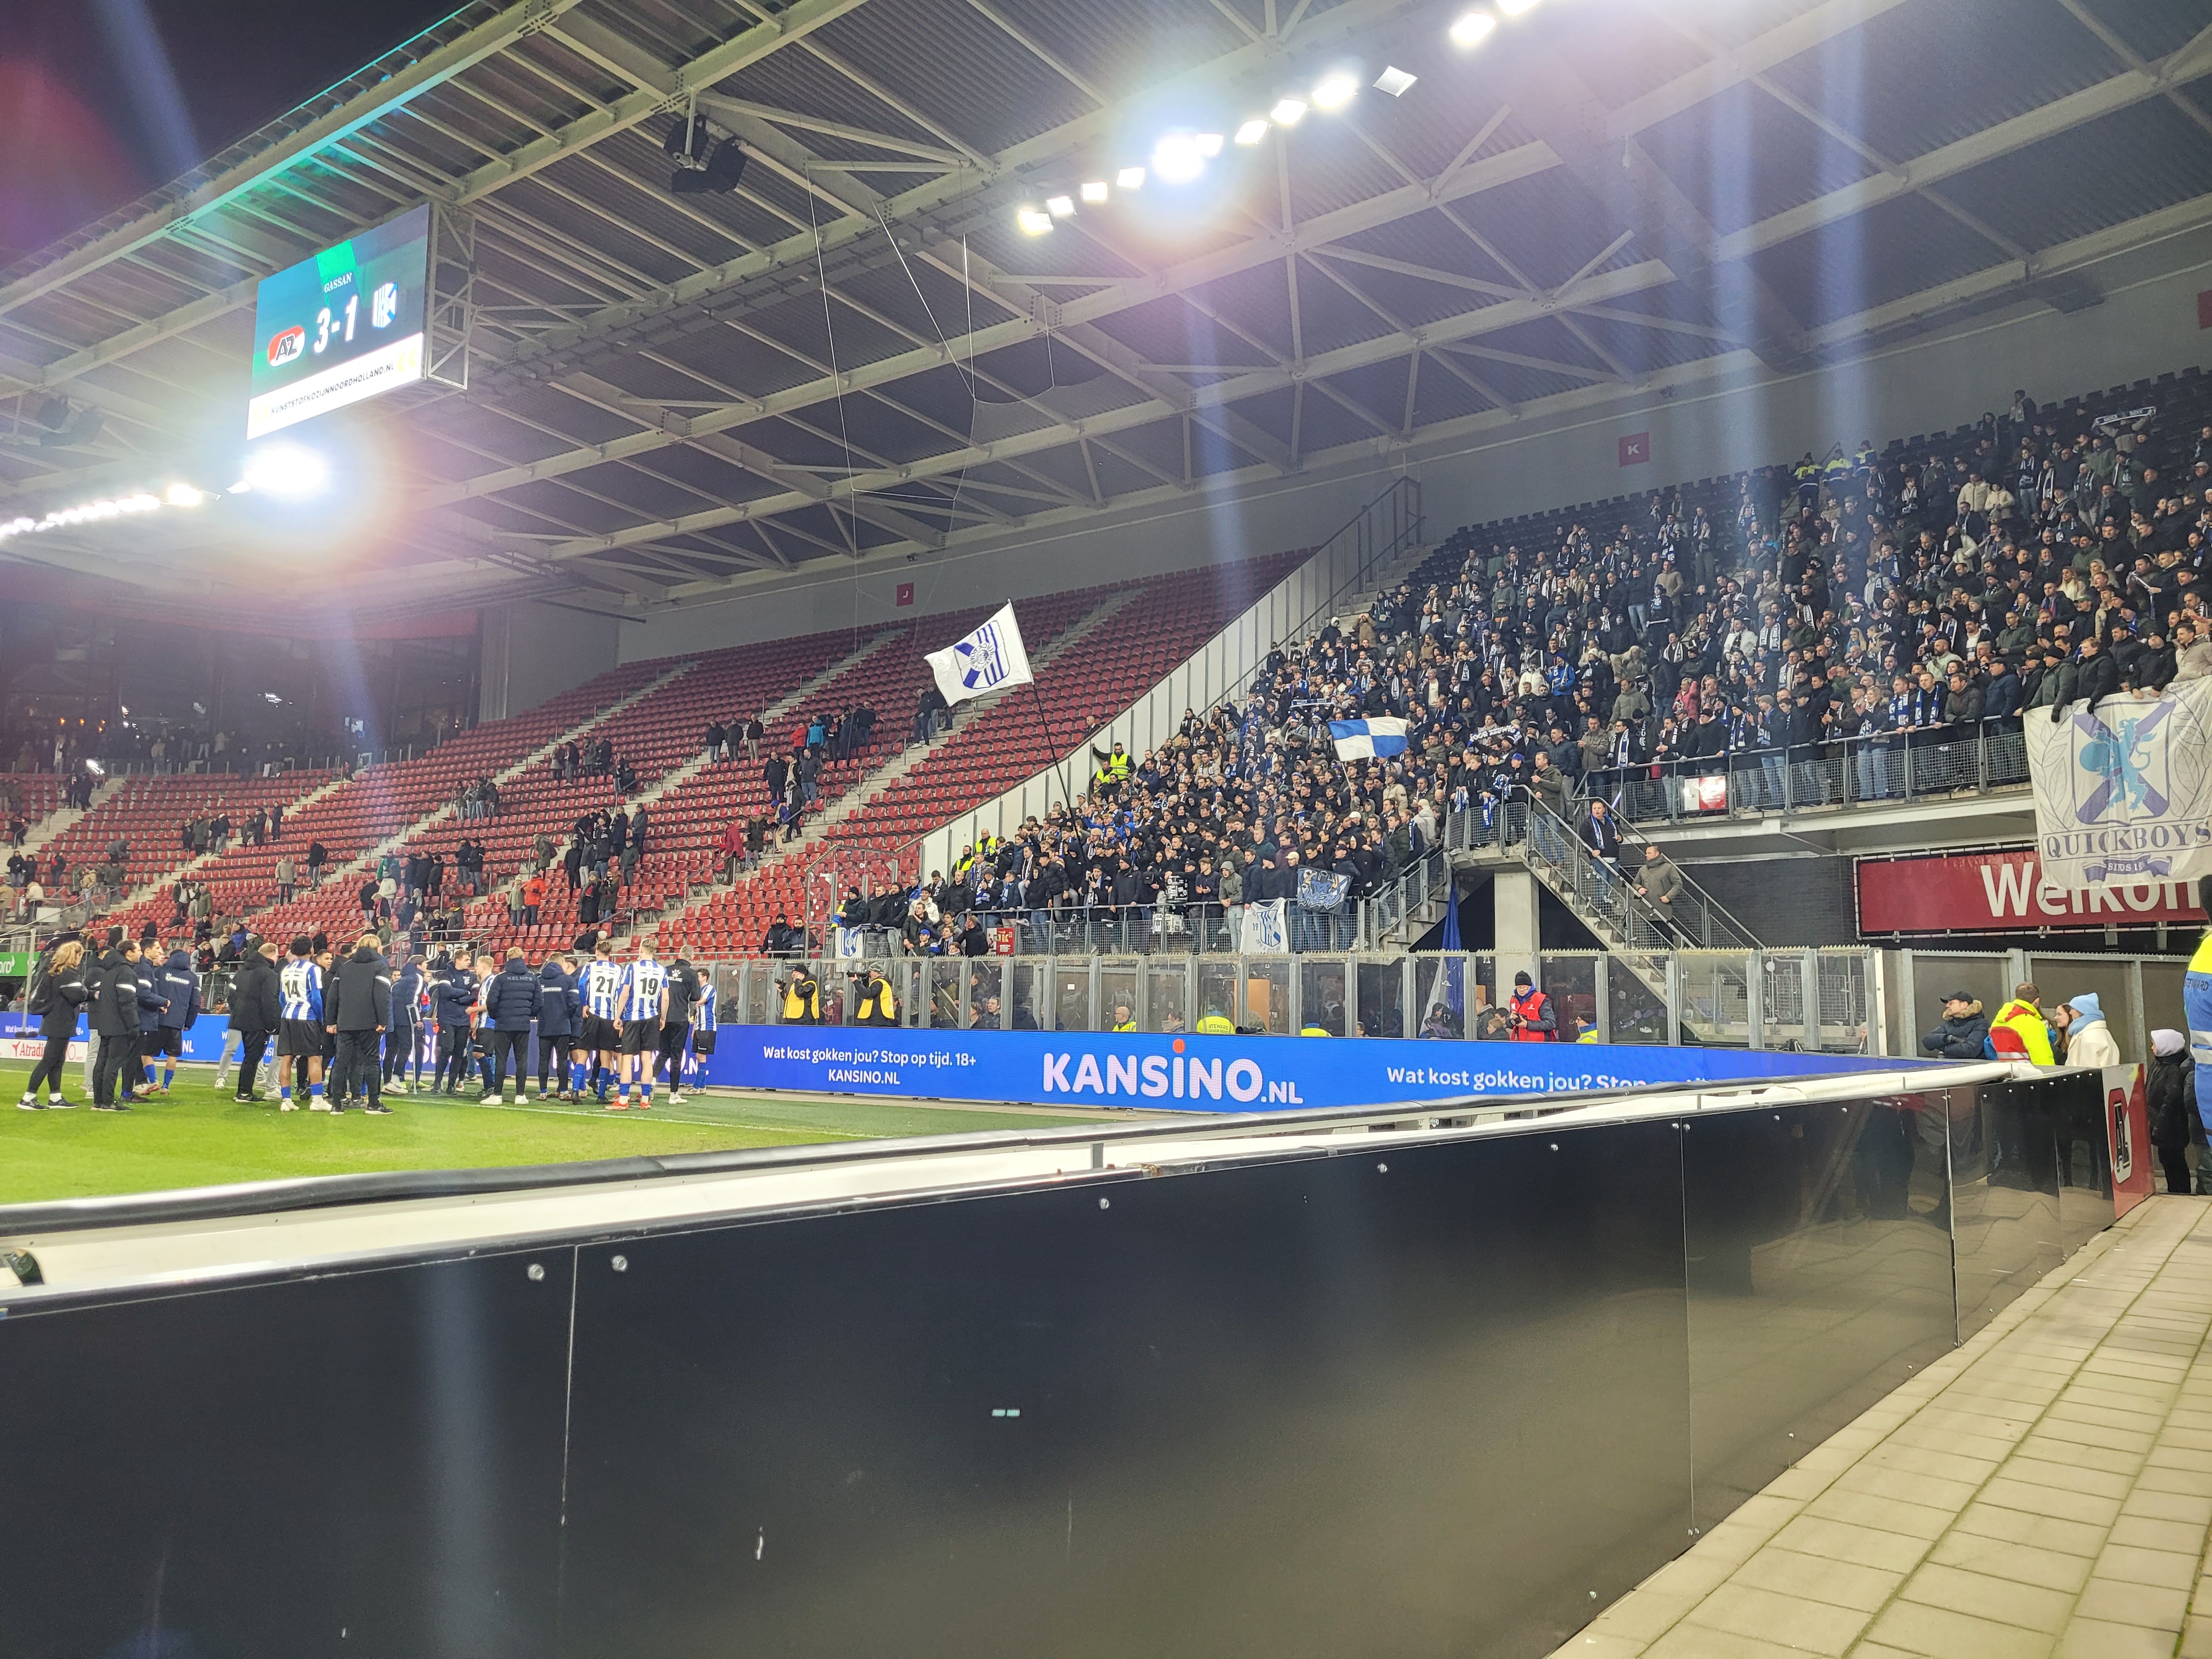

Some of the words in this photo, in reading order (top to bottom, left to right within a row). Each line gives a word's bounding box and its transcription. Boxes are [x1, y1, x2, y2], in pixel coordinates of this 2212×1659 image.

[324, 272, 353, 294] GASSAN
[275, 334, 298, 361] AZ
[270, 362, 394, 415] KUNSTSTOFKOZIJNNOORDHOLLAND.NL
[1628, 444, 1640, 455] K
[902, 590, 909, 598] J
[285, 980, 301, 998] 14
[596, 976, 614, 994] 21
[640, 977, 658, 996] 19
[20, 1043, 44, 1057] Atradi
[763, 1046, 785, 1059] Wat
[787, 1046, 811, 1060] kost
[812, 1047, 853, 1063] gokken
[853, 1049, 879, 1065] jou?
[881, 1050, 909, 1067] Stop
[911, 1054, 927, 1068] op
[928, 1052, 953, 1068] tijd.
[955, 1052, 977, 1066] 18+
[828, 1068, 901, 1085] KANSINO.NL
[1387, 1066, 1425, 1085] Wat
[1429, 1067, 1469, 1086] kost
[1473, 1068, 1543, 1091] gokken
[1548, 1071, 1592, 1091] jou?
